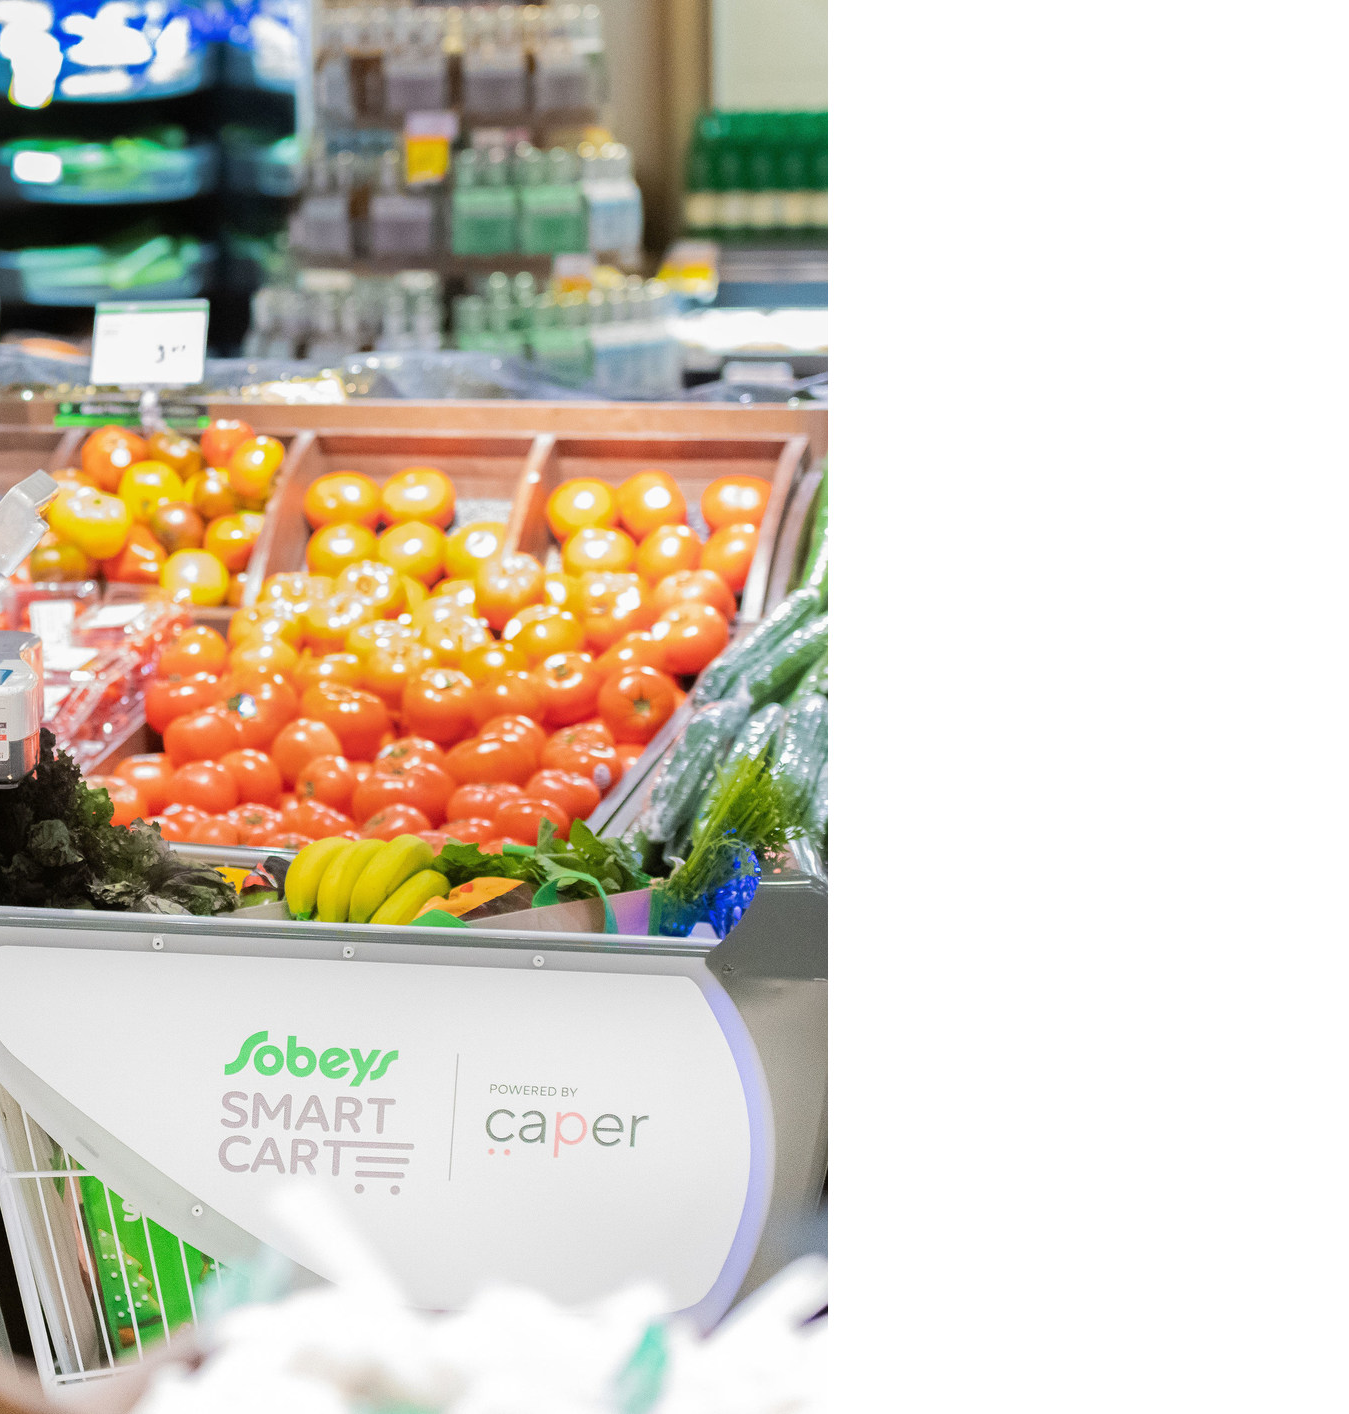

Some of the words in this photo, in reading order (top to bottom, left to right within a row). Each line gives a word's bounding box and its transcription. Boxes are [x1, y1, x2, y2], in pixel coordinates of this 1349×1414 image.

[224, 1031, 399, 1087] Sobeys
[489, 1083, 557, 1097] POWERED
[561, 1086, 579, 1098] BY
[221, 1091, 397, 1135] SMART
[486, 1108, 650, 1158] caper
[218, 1135, 347, 1177] CART
